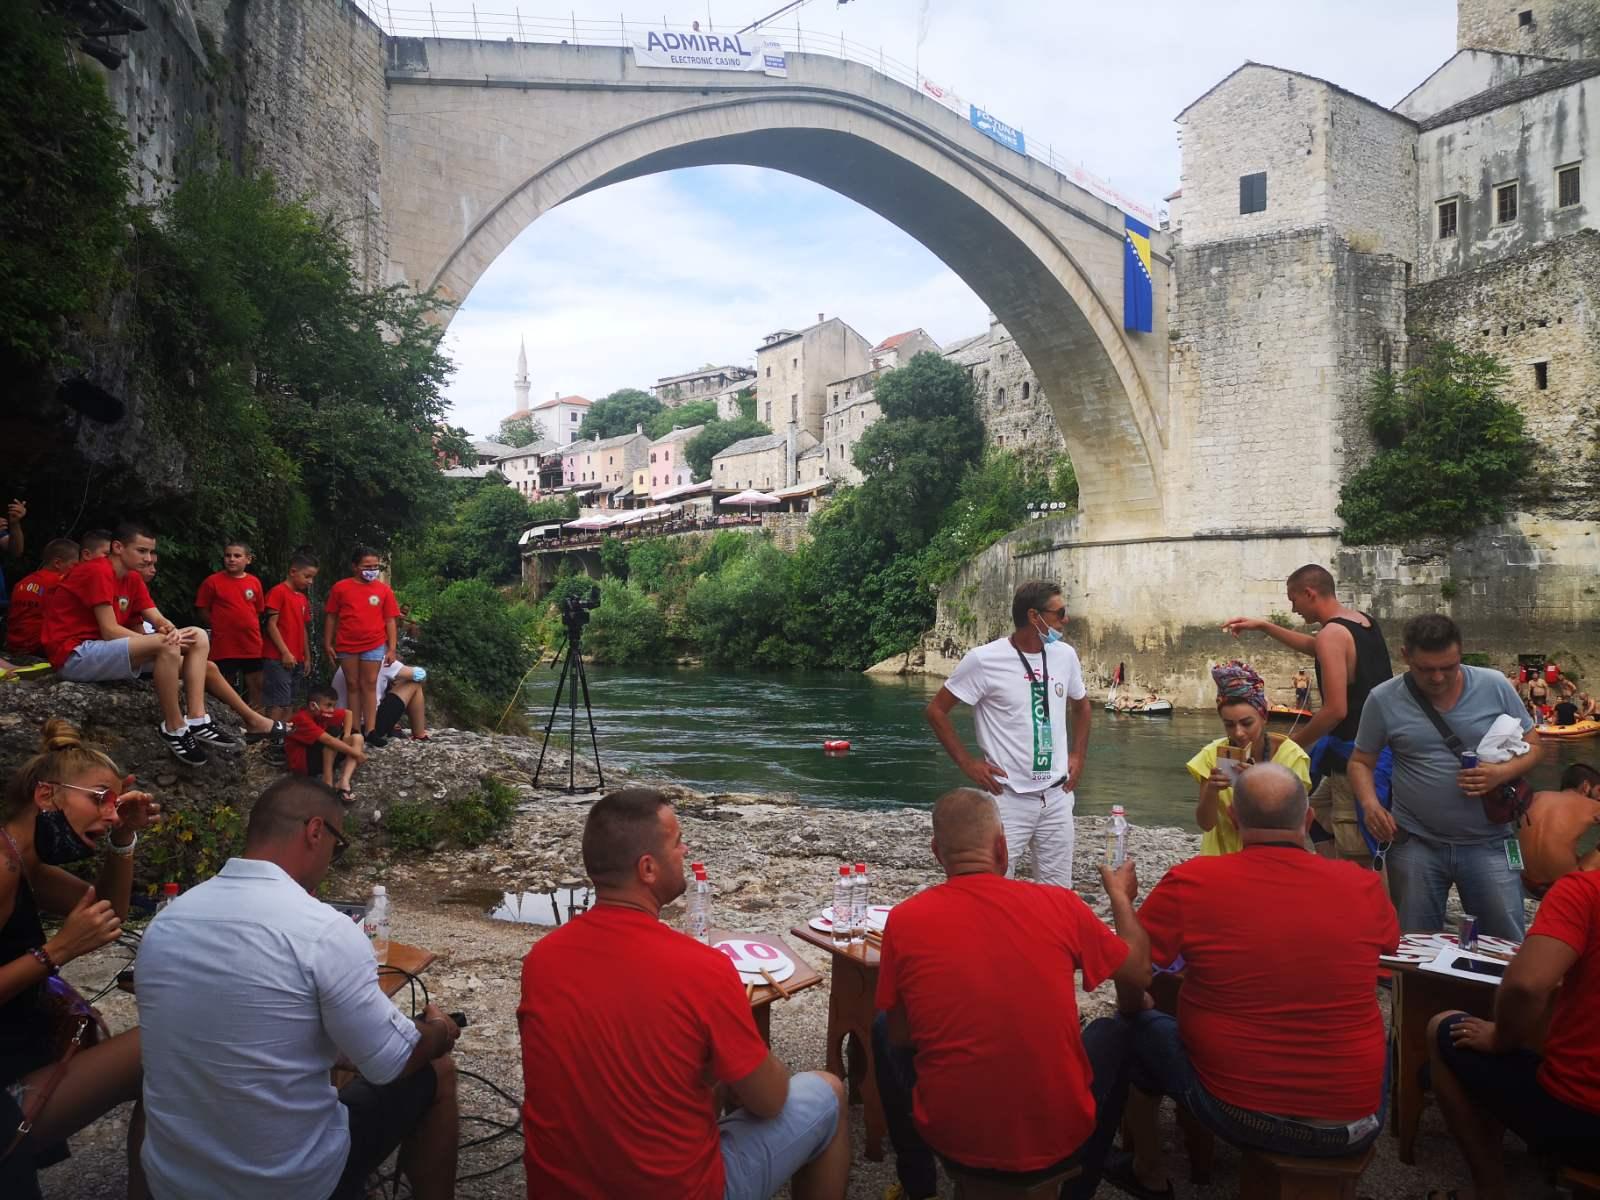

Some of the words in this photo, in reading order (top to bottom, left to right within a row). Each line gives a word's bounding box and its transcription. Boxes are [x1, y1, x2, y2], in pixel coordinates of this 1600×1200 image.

[648, 31, 751, 56] ADMIRAL
[671, 55, 713, 65] ELECTRONIC
[715, 57, 741, 66] CASINO
[976, 110, 1017, 138] FOTUNA
[720, 943, 779, 961] 10
